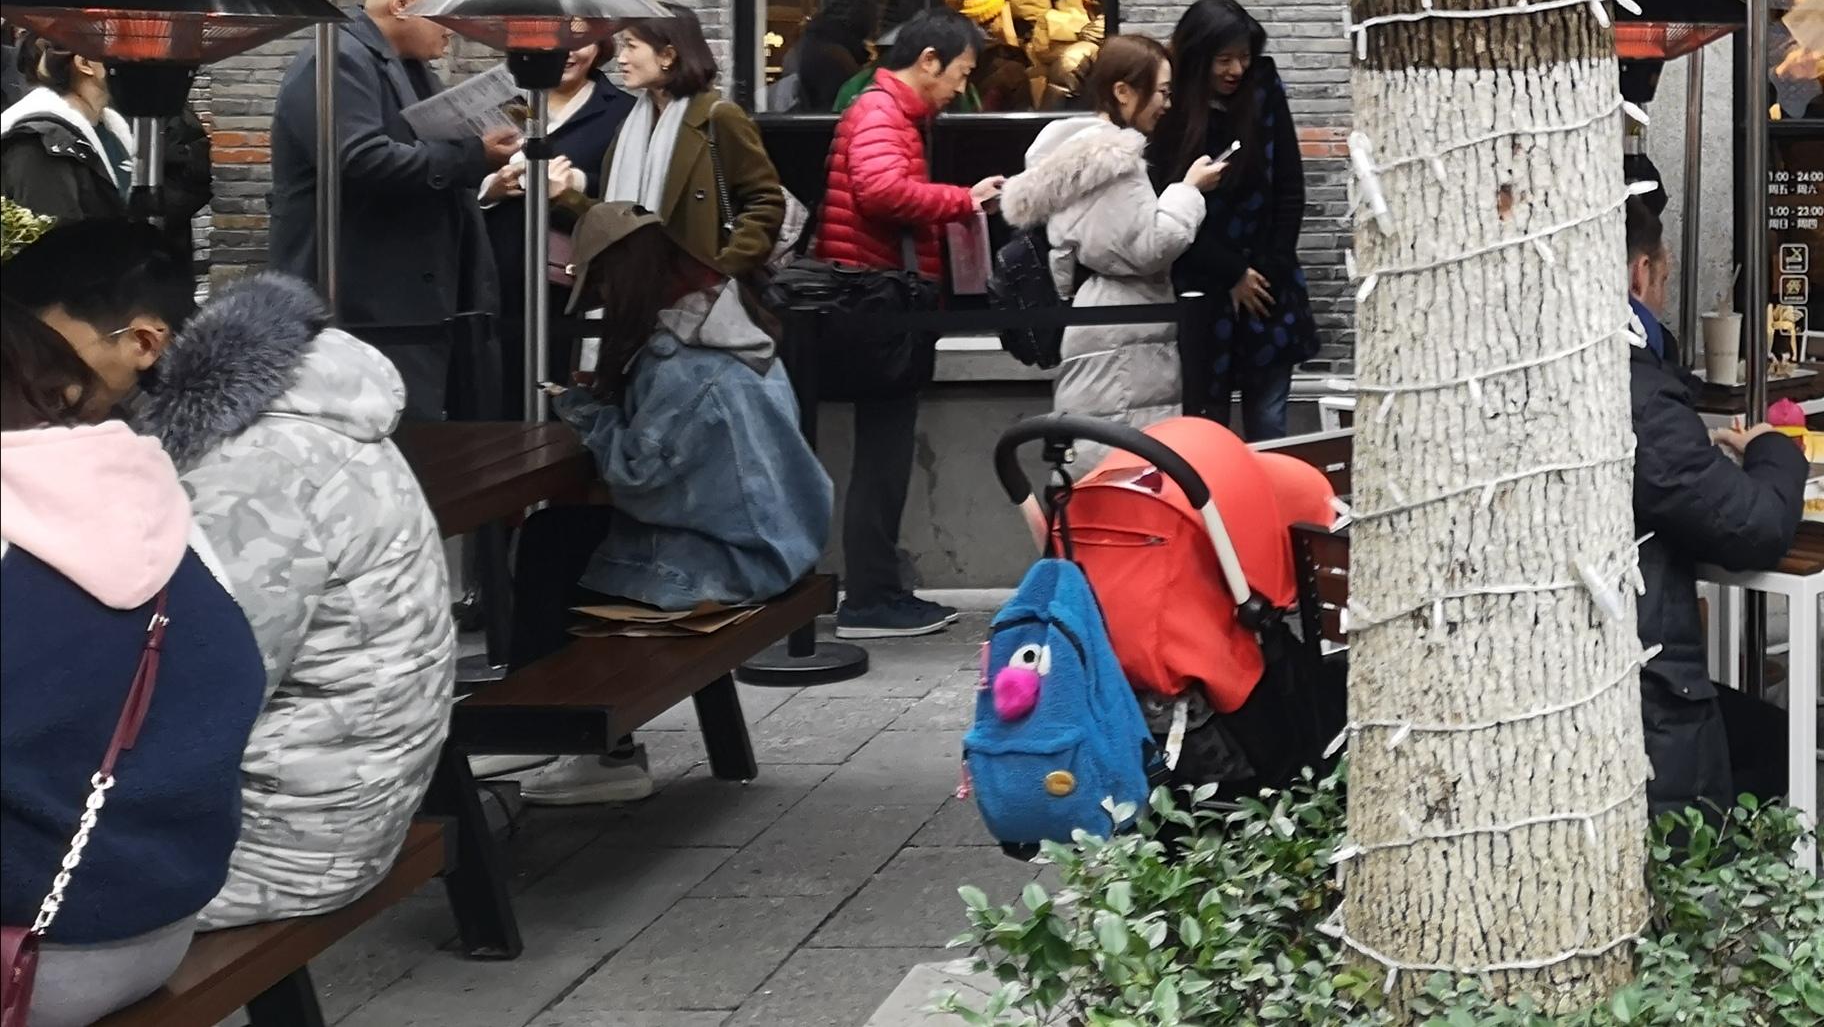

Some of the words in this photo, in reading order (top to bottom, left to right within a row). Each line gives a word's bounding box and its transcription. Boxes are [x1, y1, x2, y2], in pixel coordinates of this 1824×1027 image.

[1768, 172, 1790, 181] 1:00
[1797, 172, 1824, 182] 24:00
[1768, 206, 1790, 217] 1:00
[1797, 206, 1824, 217] 23:00
